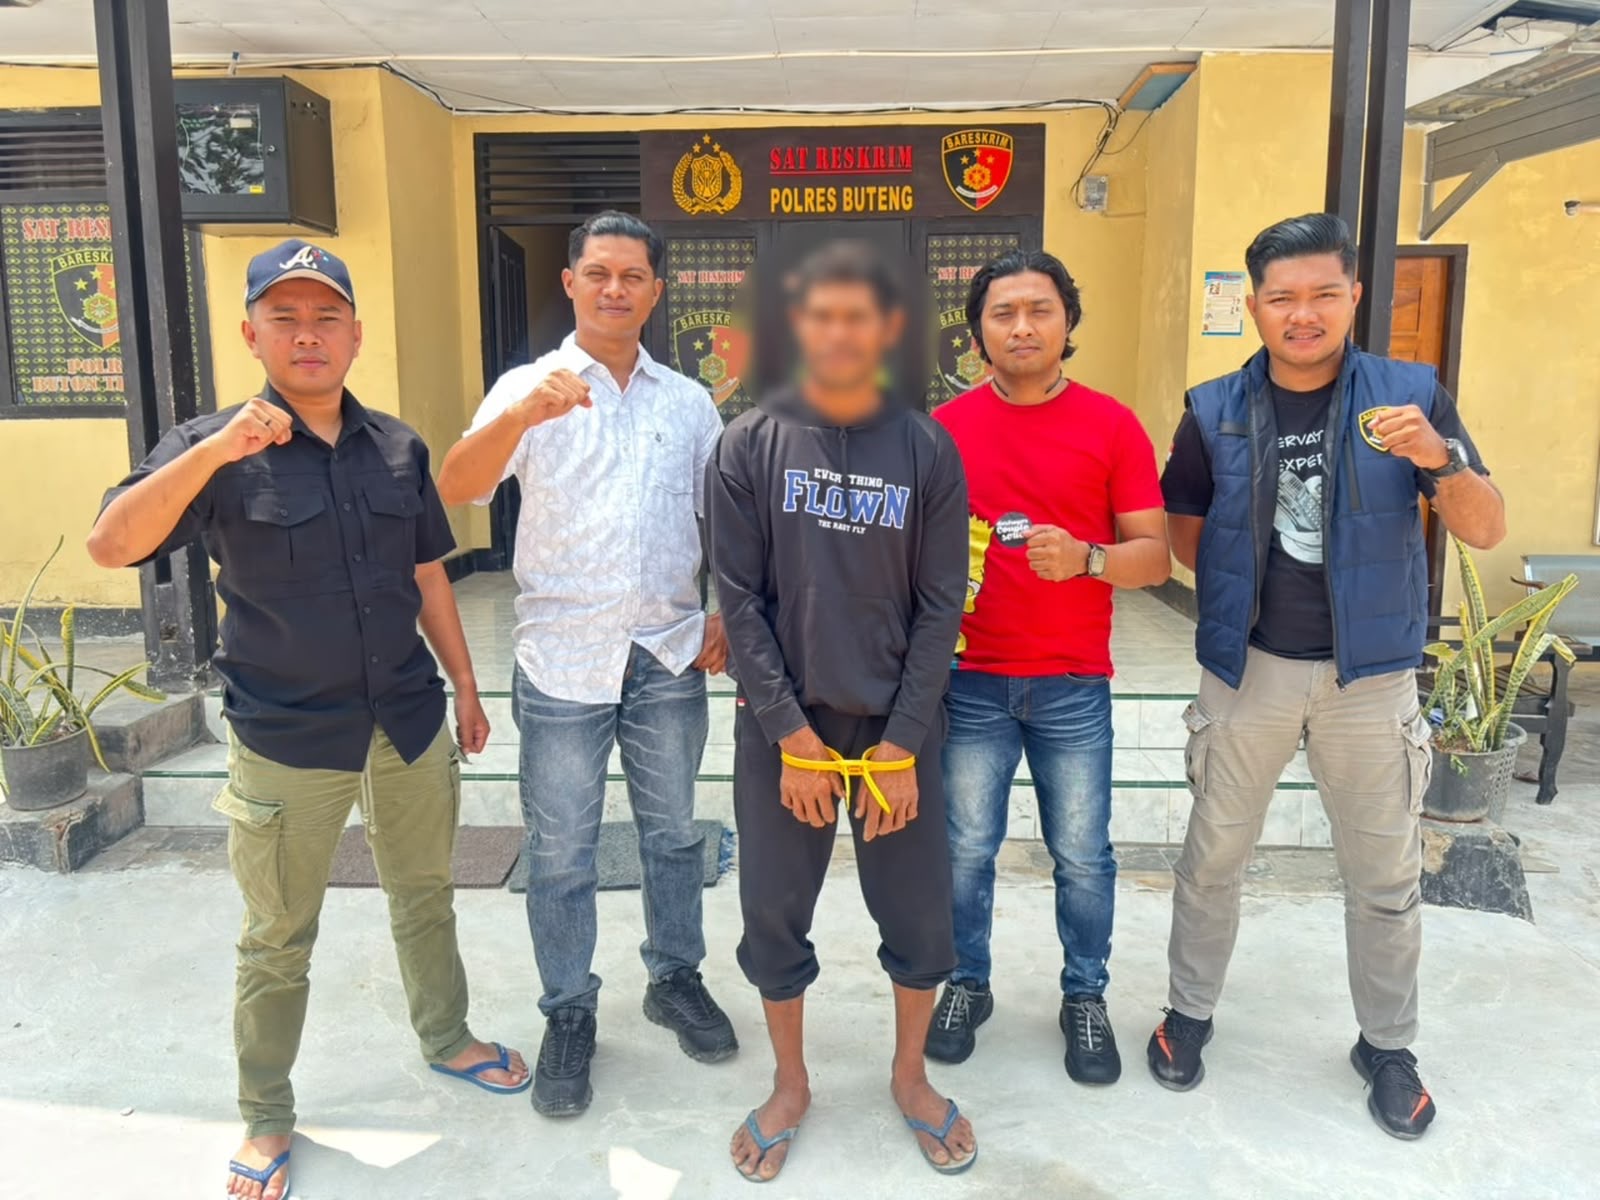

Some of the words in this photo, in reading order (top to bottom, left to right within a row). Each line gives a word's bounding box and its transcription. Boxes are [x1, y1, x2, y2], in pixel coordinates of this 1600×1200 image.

[946, 132, 1009, 149] BARESKRIM
[770, 147, 808, 170] SAT
[816, 145, 912, 169] RESKRIM
[770, 187, 837, 213] POLRES
[842, 185, 913, 212] BUTENG
[22, 218, 60, 239] SAT
[814, 468, 842, 483] EVER
[848, 474, 883, 488] THING
[783, 469, 910, 529] FLOWN
